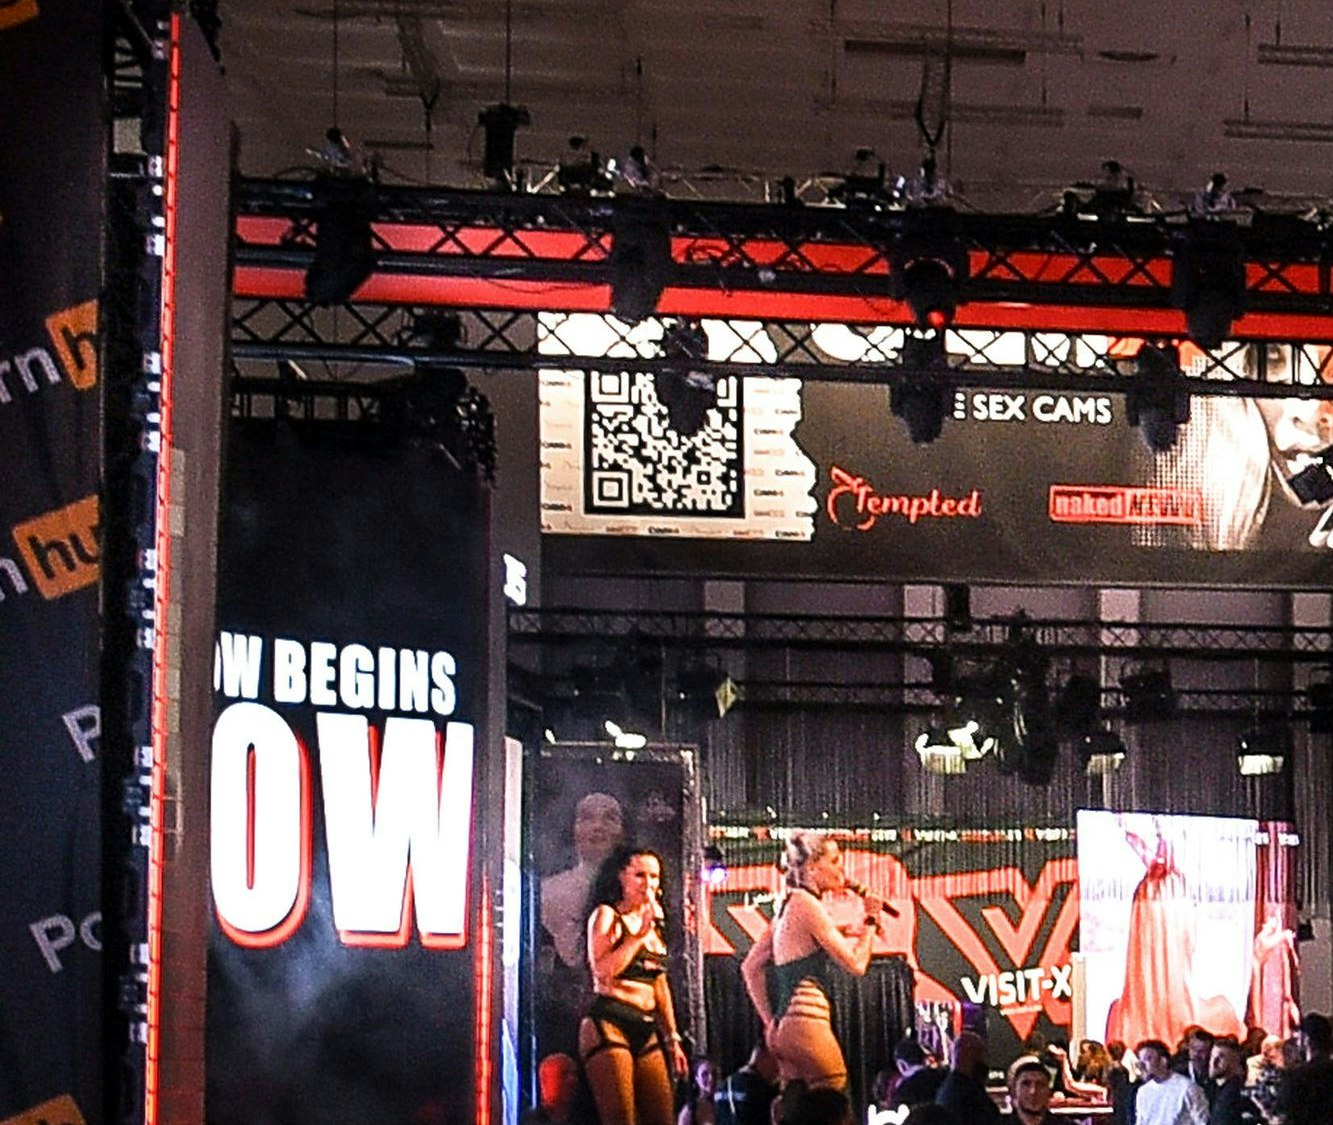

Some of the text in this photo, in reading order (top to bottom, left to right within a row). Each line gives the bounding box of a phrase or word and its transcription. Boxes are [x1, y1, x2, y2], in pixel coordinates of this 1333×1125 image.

[972, 393, 1026, 422] SEX
[1033, 396, 1112, 424] CAMS
[854, 483, 983, 524] Tempted
[213, 631, 457, 716] W BEGINS
[961, 964, 1072, 1007] VISIT-X
